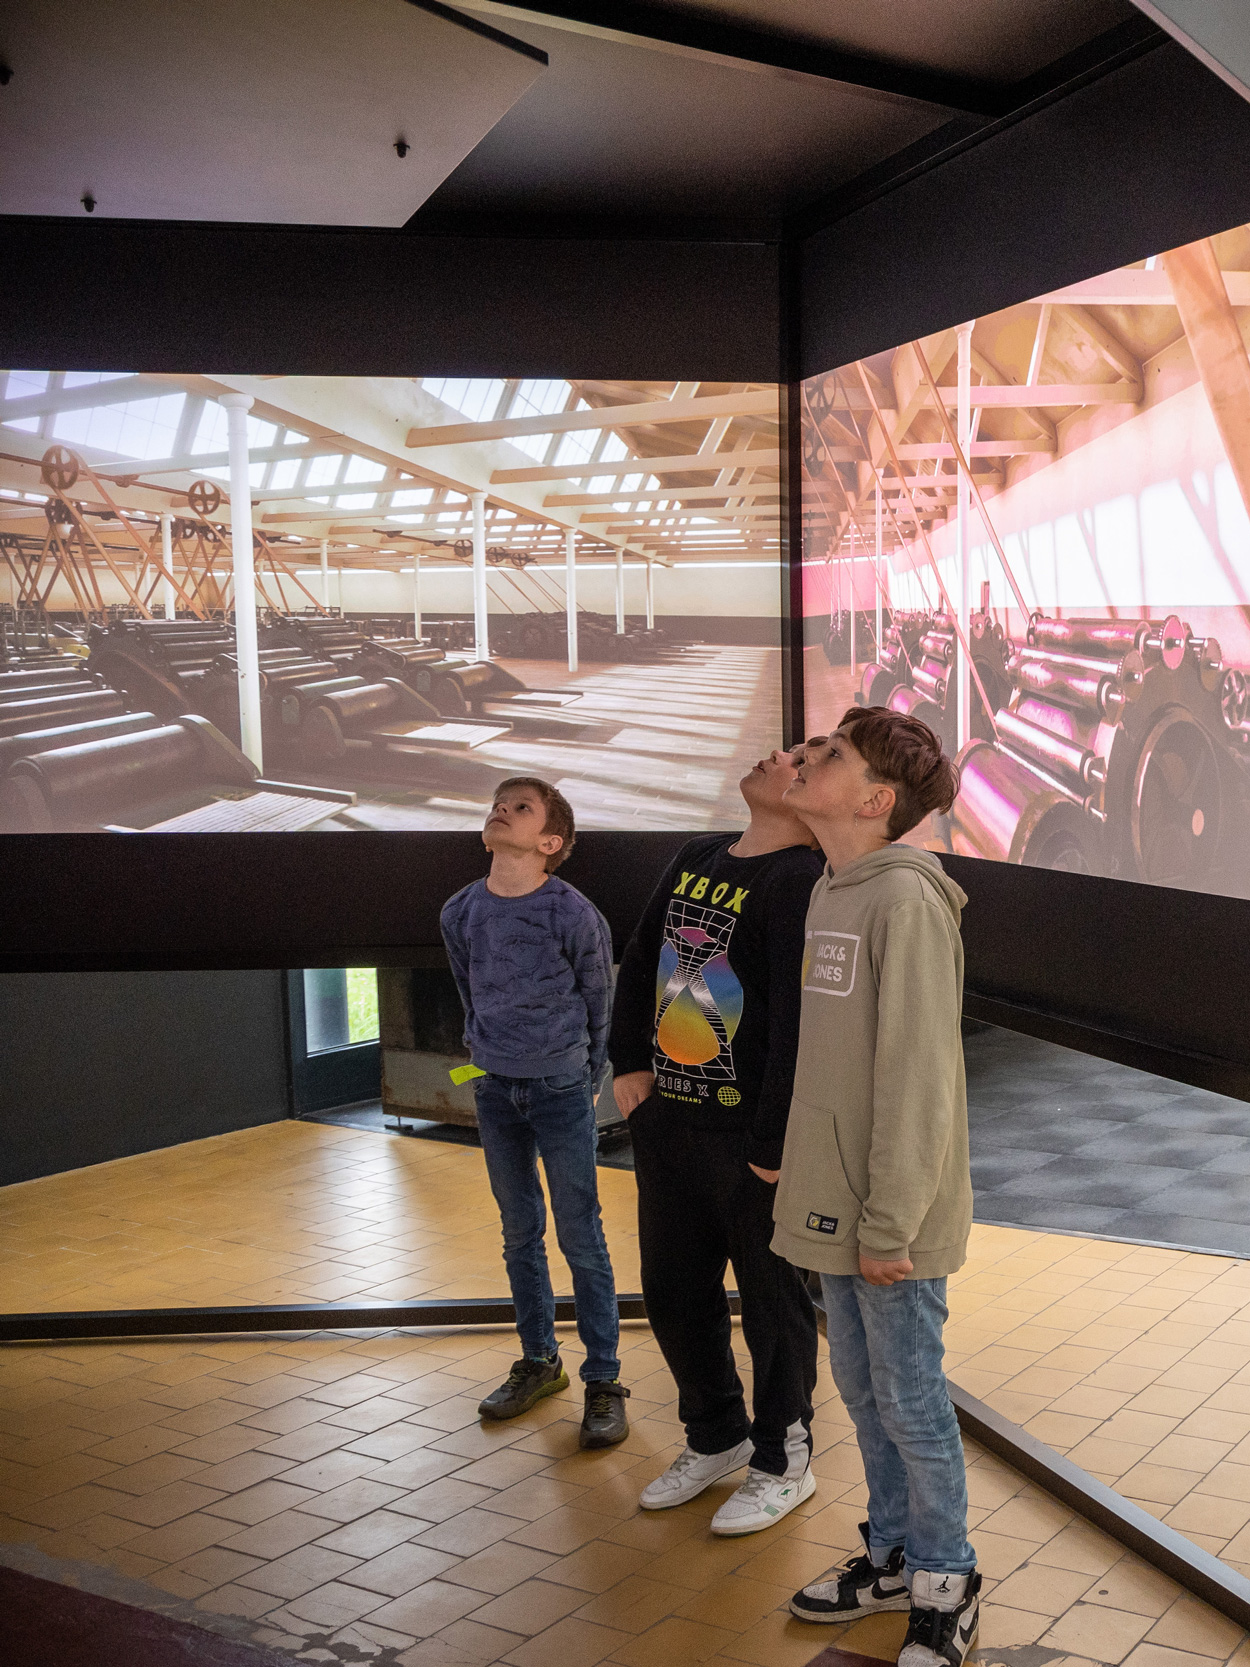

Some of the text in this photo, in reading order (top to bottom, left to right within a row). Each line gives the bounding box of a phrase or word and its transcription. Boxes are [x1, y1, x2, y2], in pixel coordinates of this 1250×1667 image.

[672, 871, 750, 914] XBOX
[696, 1083, 710, 1097] X
[660, 1091, 702, 1105] YOUR DREAMS
